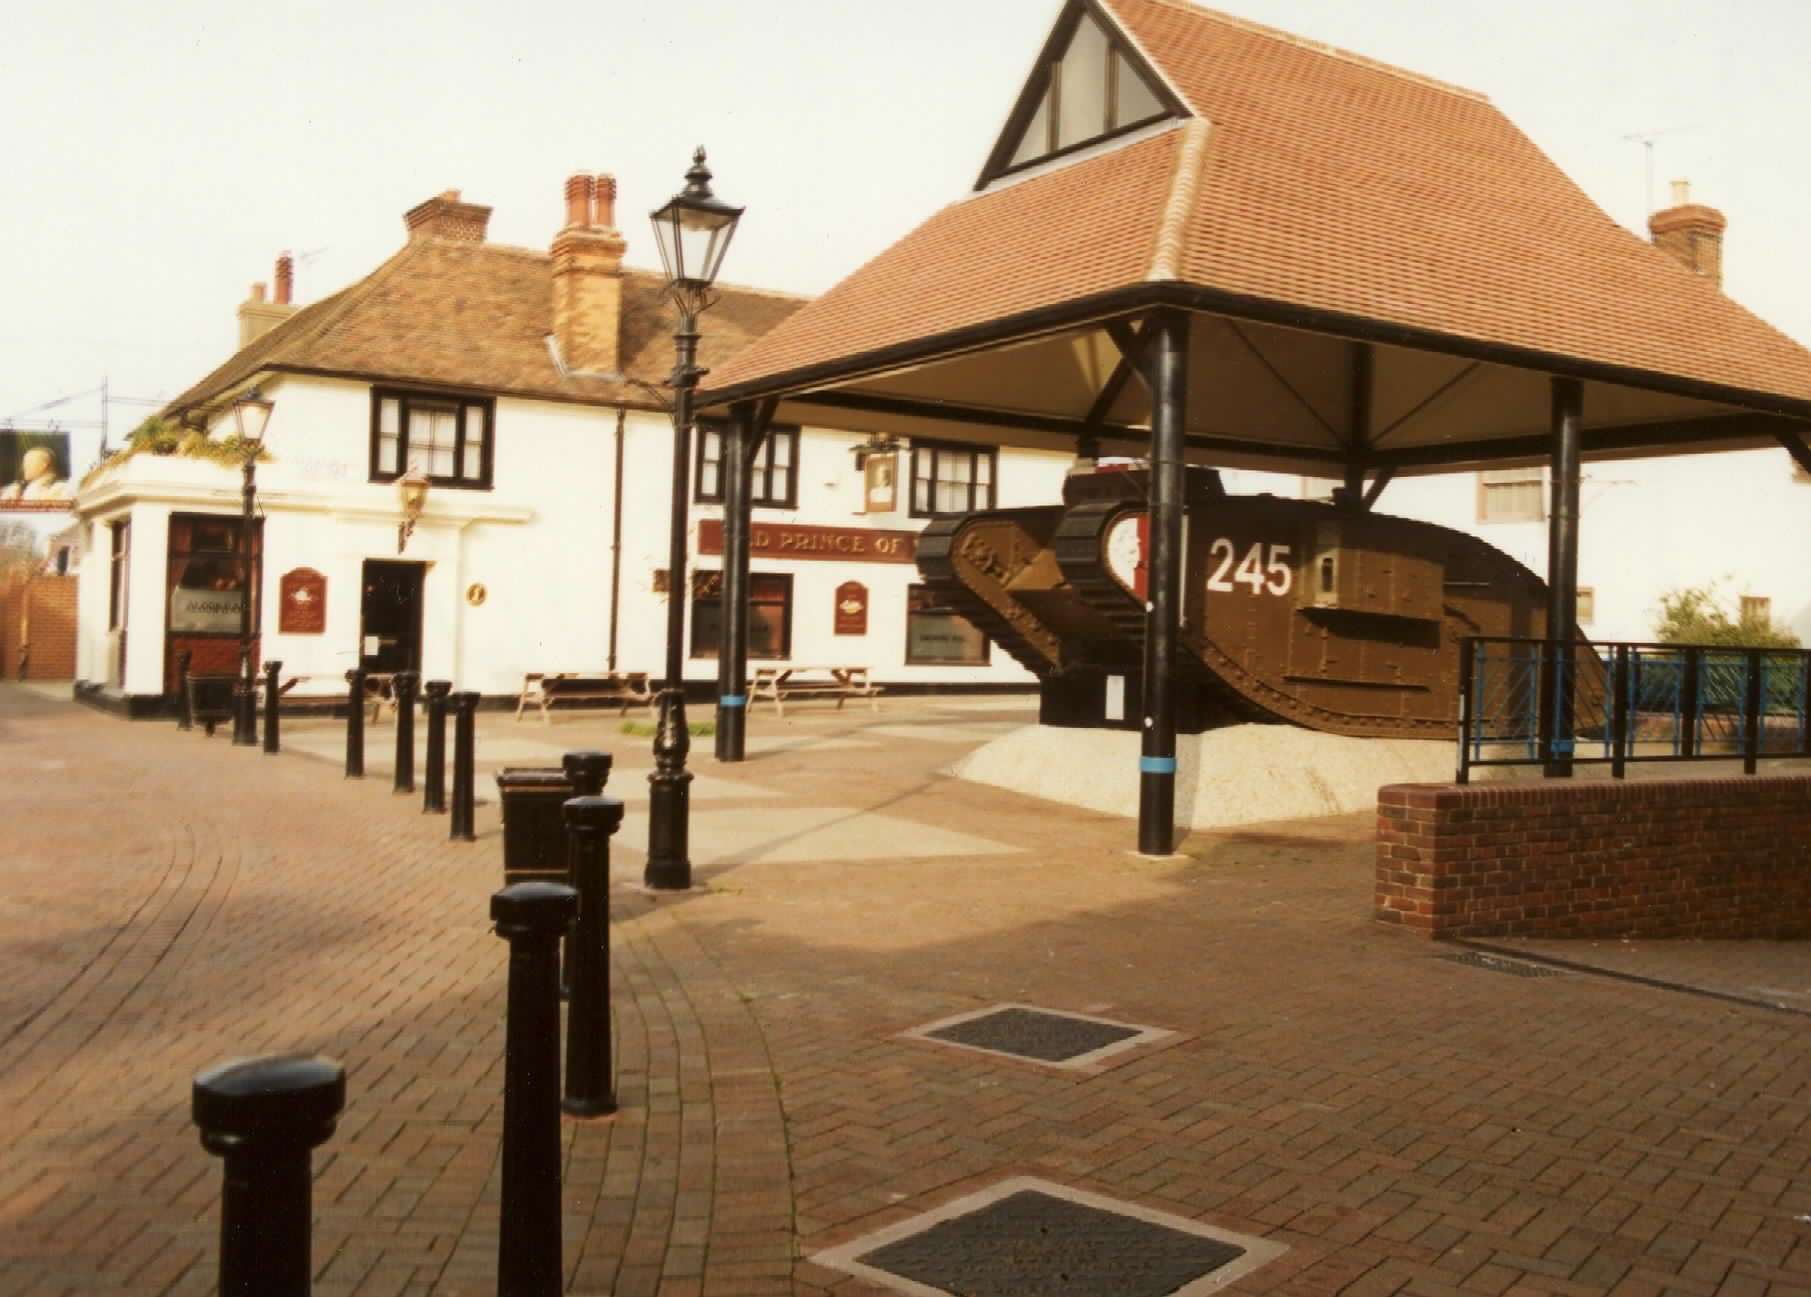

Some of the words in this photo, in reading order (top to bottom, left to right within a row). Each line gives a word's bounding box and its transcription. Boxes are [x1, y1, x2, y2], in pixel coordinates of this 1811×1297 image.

[780, 532, 865, 553] PRINCE
[873, 536, 904, 554] OF
[1206, 537, 1292, 597] 245
